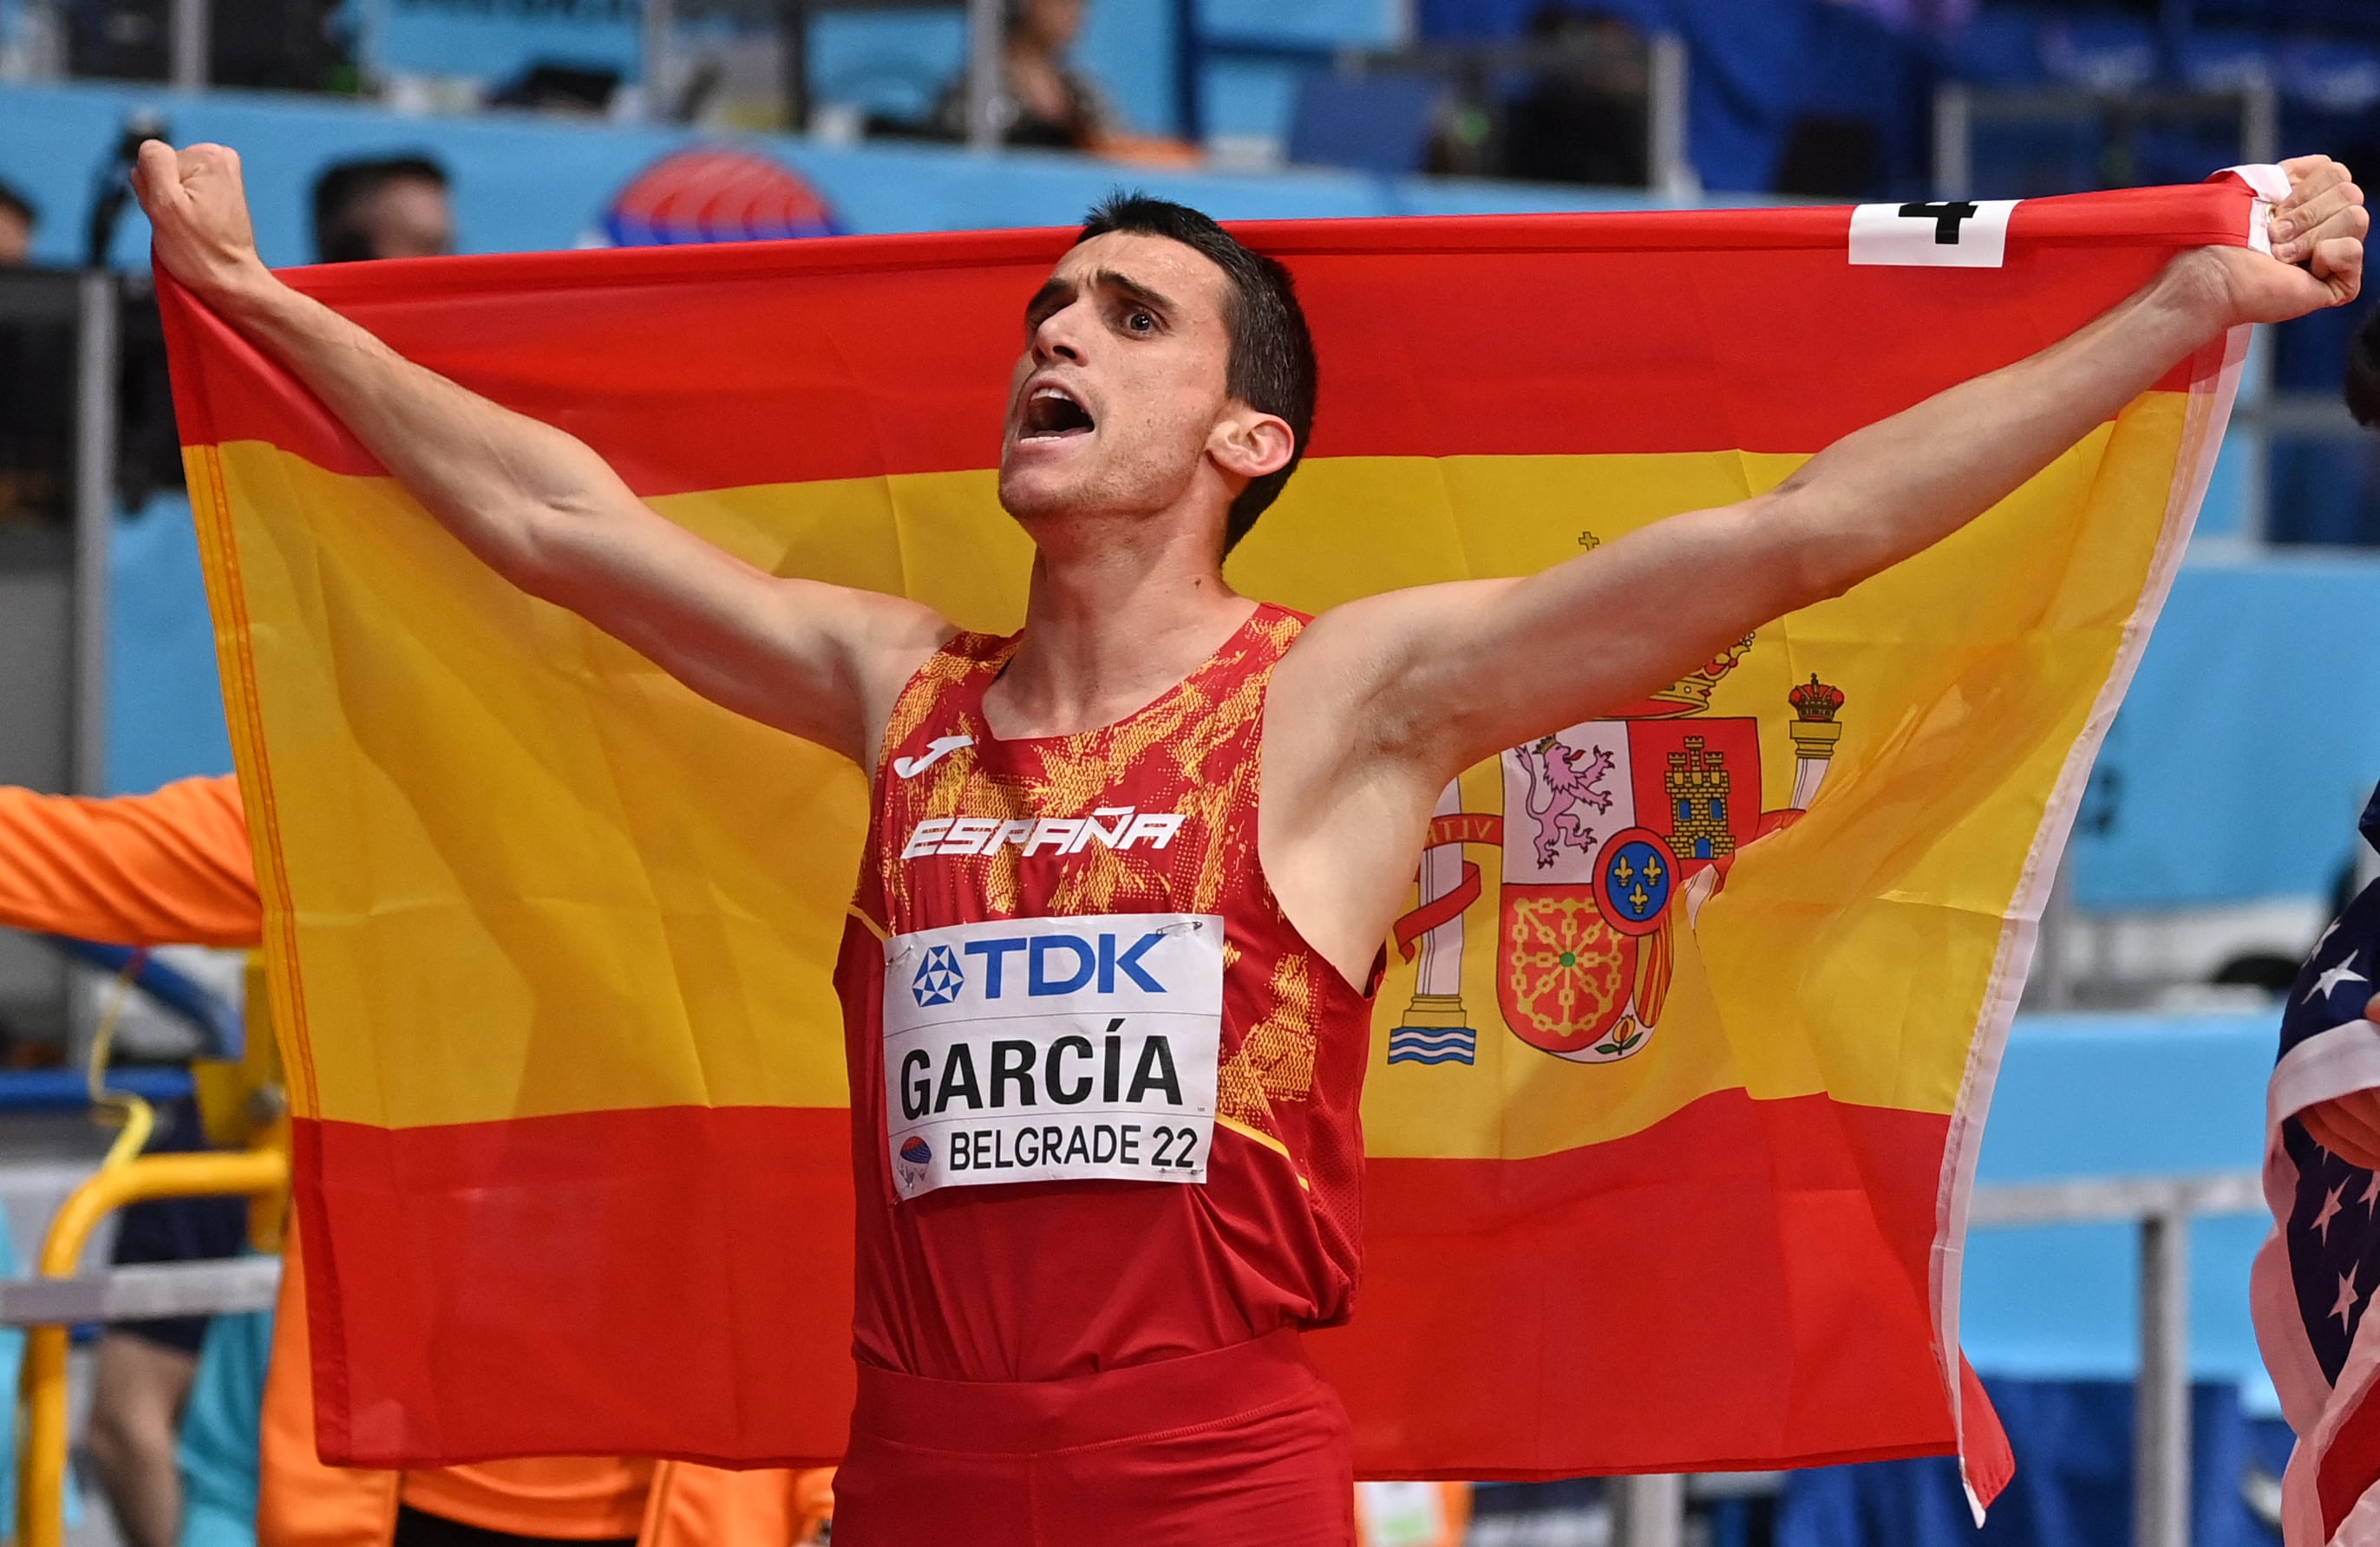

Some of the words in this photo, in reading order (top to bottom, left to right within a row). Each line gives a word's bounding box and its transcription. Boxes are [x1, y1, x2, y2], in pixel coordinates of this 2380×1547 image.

[899, 806, 1186, 858] ESPAÑA
[964, 933, 1168, 999] TDK
[900, 1018, 1183, 1120] GARCÍA
[950, 1125, 1141, 1171] BELGRADE
[1152, 1126, 1198, 1167] 22
